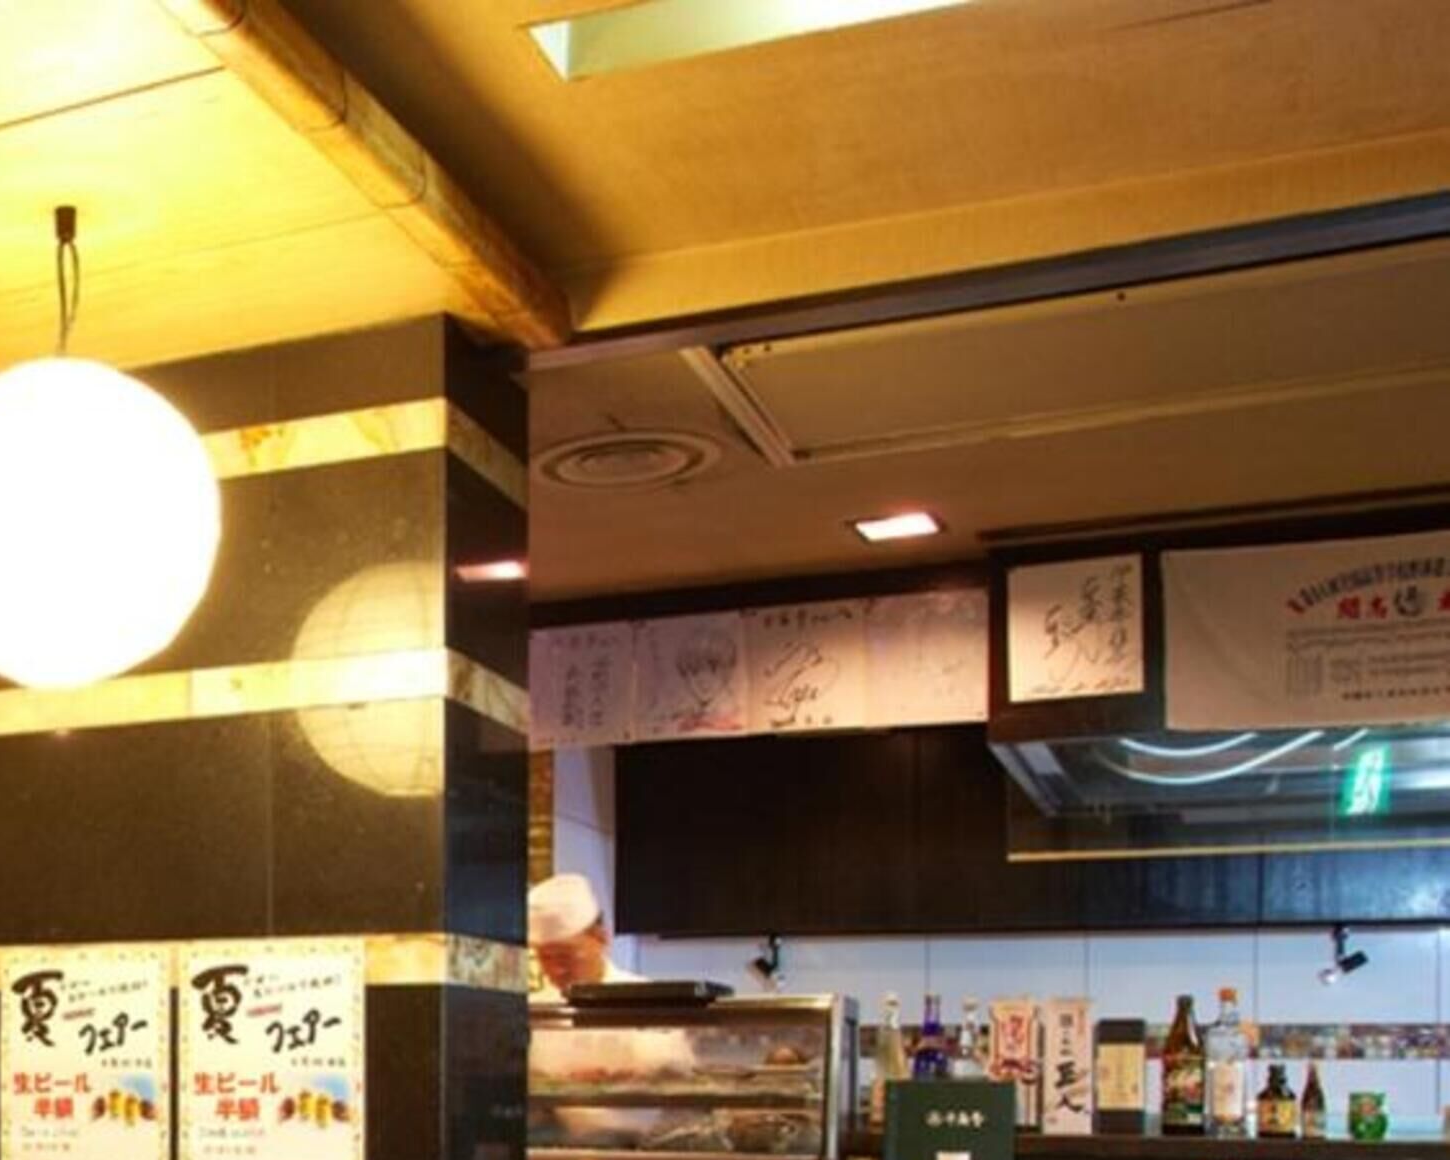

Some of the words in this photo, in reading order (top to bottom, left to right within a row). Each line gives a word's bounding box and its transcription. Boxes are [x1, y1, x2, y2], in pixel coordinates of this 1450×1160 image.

[11, 969, 64, 1047] 夏
[190, 963, 249, 1044] 夏
[13, 1071, 91, 1095] 生ビール
[193, 1071, 281, 1095] 生ビール
